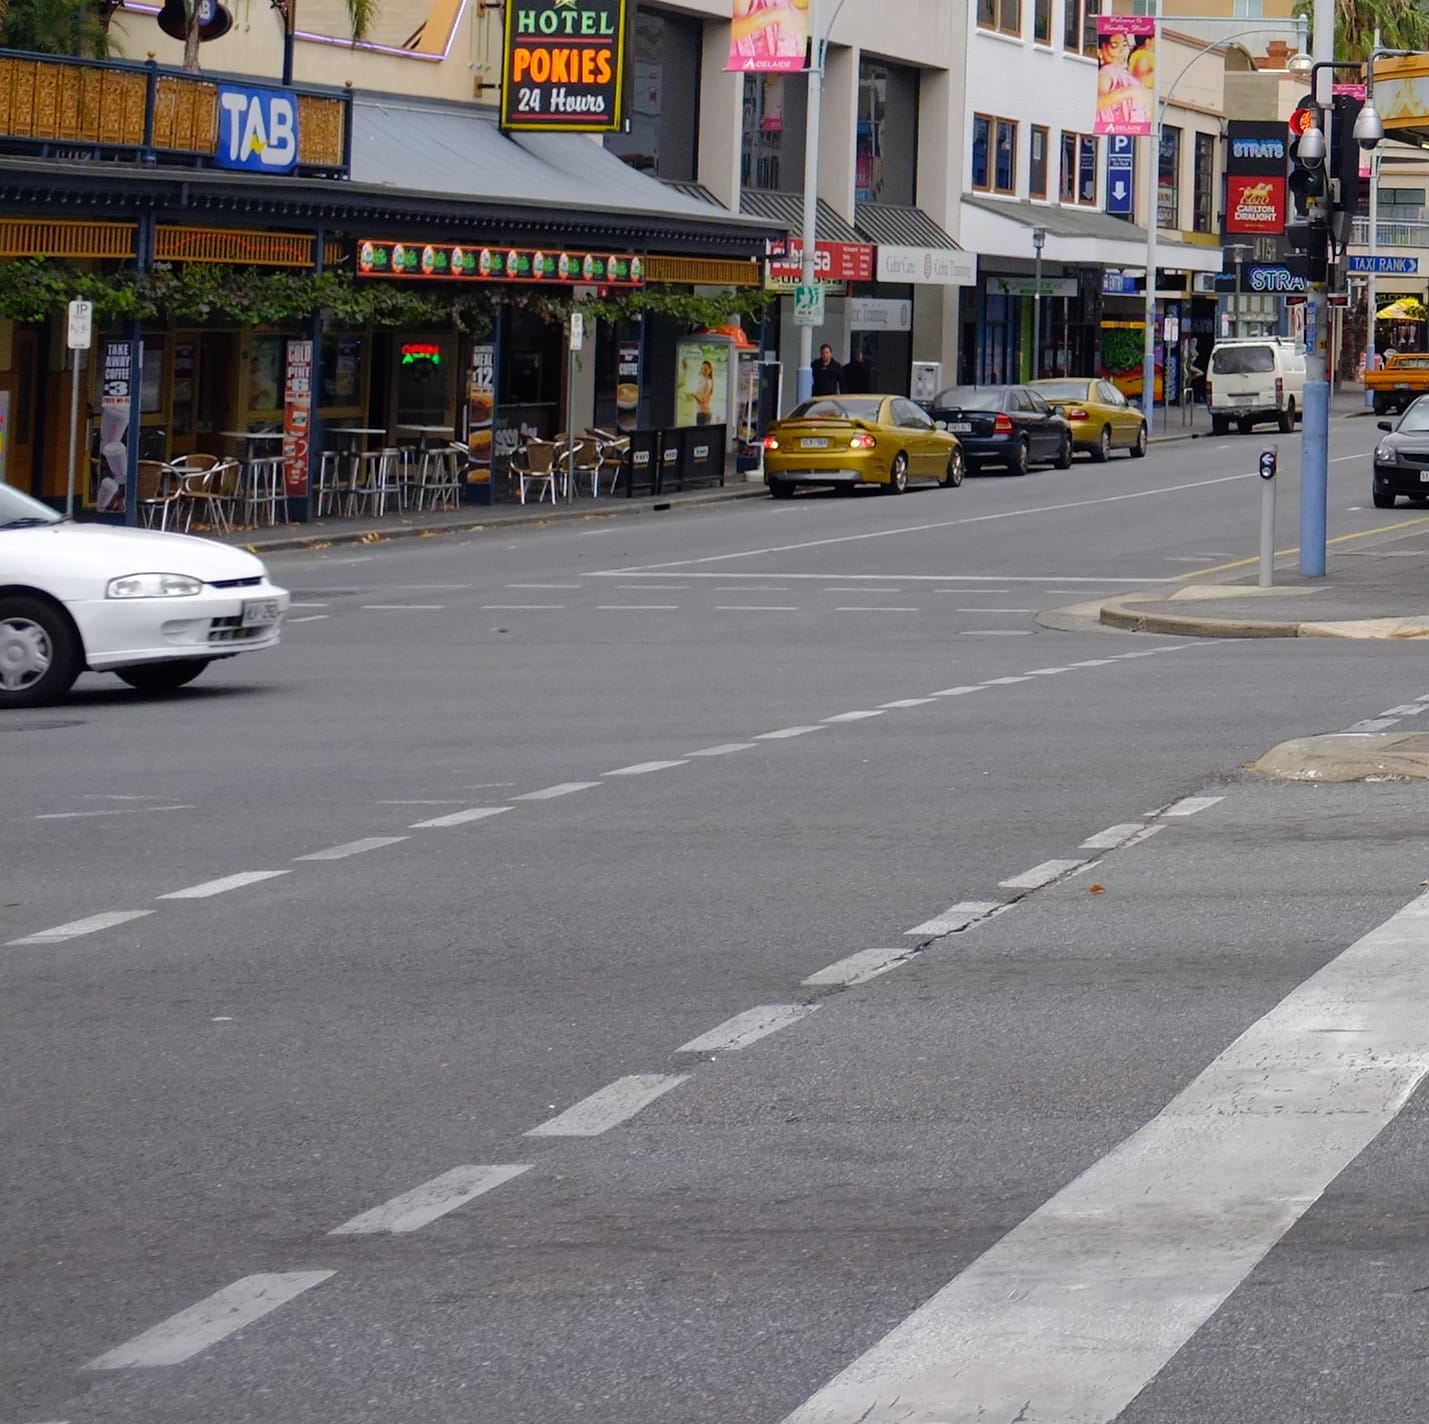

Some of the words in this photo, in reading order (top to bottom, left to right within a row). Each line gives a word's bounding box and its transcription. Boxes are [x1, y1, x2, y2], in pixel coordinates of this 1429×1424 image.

[517, 9, 615, 35] HOTEL
[513, 47, 612, 84] POKIES
[518, 87, 541, 112] 24
[550, 87, 606, 112] Hours
[222, 92, 296, 166] TAB
[1233, 141, 1284, 159] STRATS
[1234, 212, 1277, 221] DRAUGHT
[1236, 205, 1275, 213] CARLTON
[1354, 257, 1376, 272] TAXI
[1379, 258, 1407, 272] RANK
[107, 344, 129, 355] TAKE
[105, 356, 131, 367] AWAY
